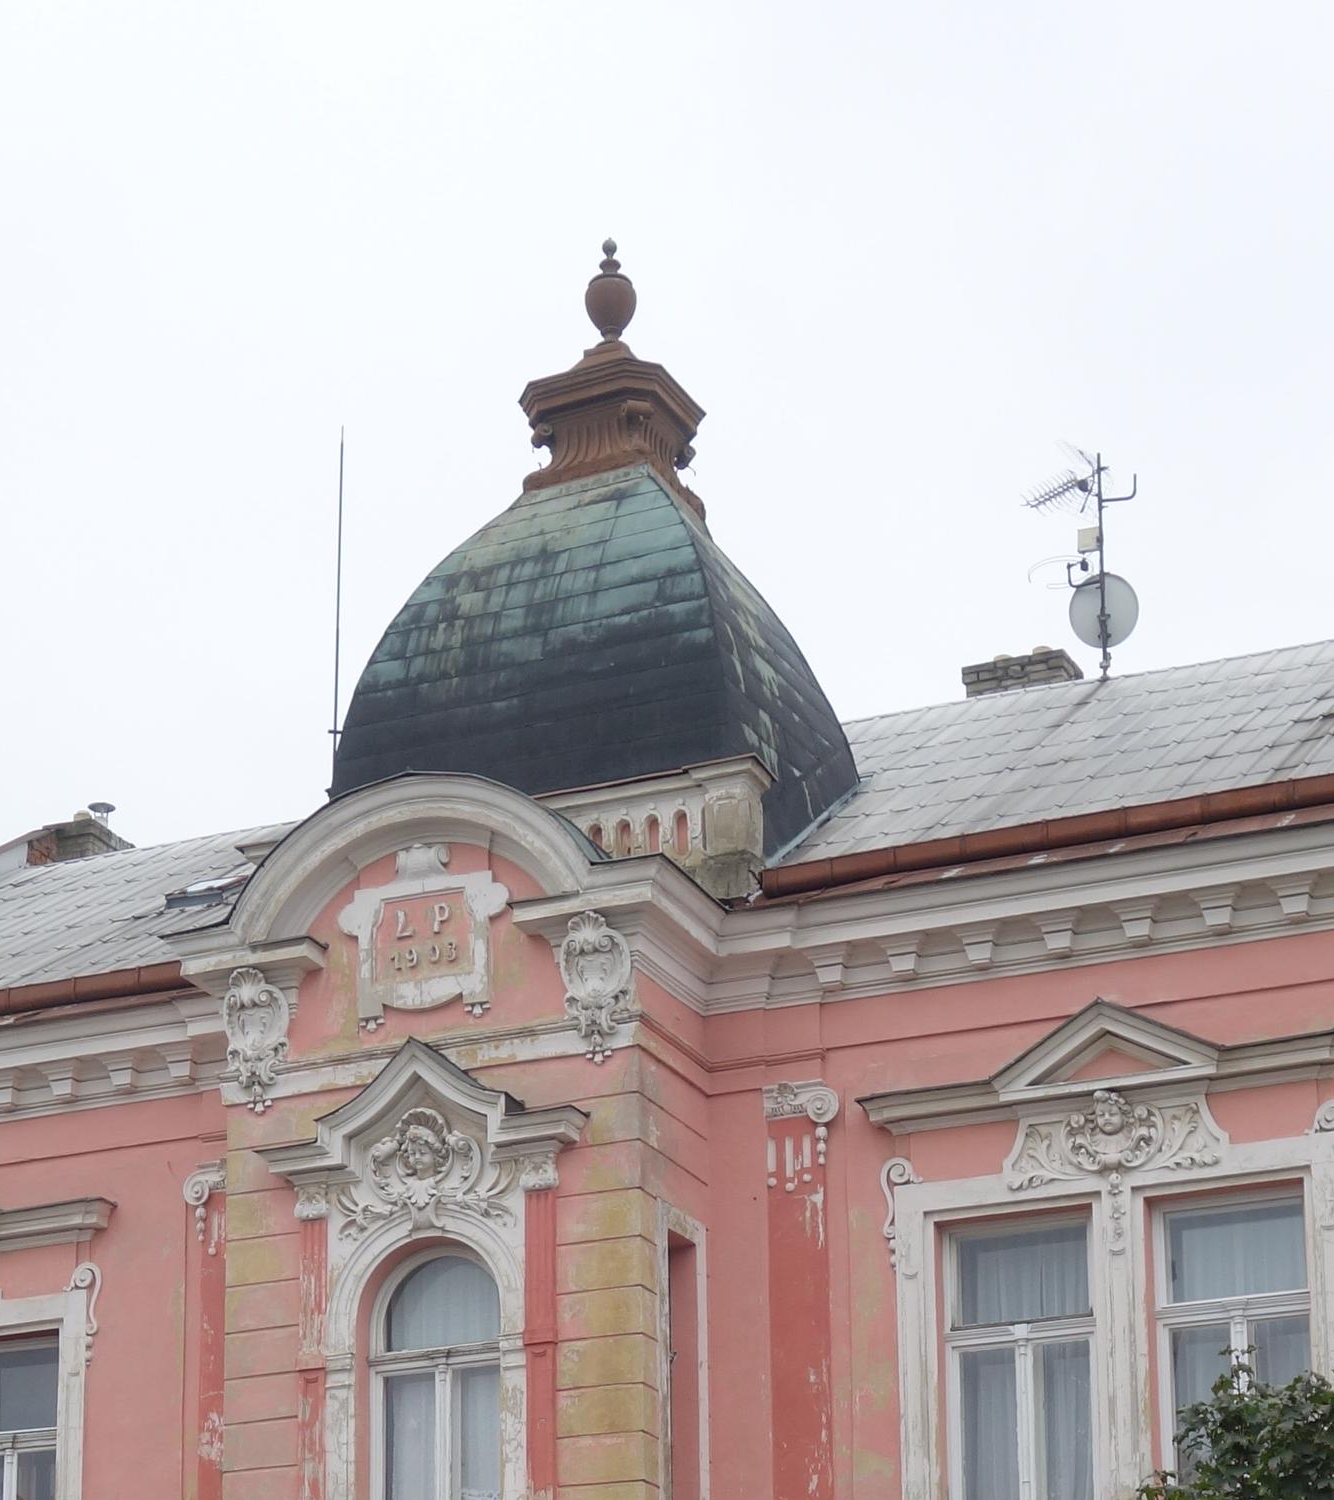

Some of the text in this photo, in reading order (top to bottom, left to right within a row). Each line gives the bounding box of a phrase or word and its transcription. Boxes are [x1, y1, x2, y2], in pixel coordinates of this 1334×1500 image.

[396, 903, 451, 940] L P
[390, 941, 458, 971] 1903
